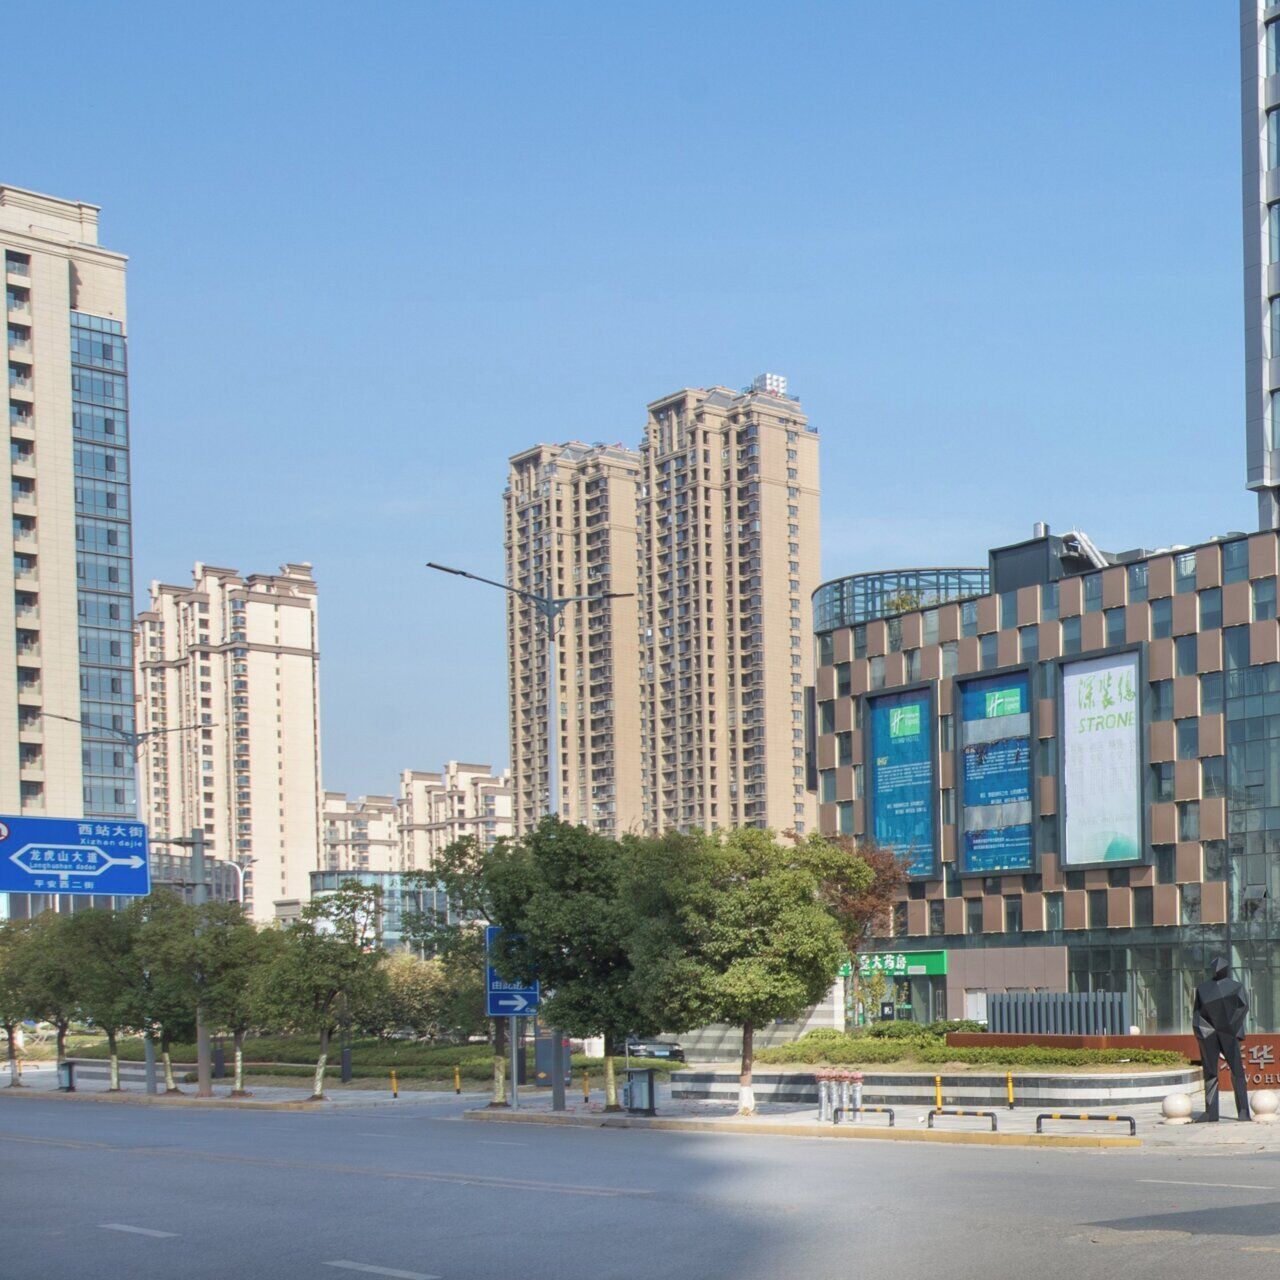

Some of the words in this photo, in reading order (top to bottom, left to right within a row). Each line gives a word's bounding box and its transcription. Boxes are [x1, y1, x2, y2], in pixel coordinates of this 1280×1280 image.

[78, 823, 143, 838] 西站大街
[80, 837, 115, 846] Xizhan
[30, 849, 98, 863] 龙虎山大道
[33, 879, 95, 889] 平安西二街
